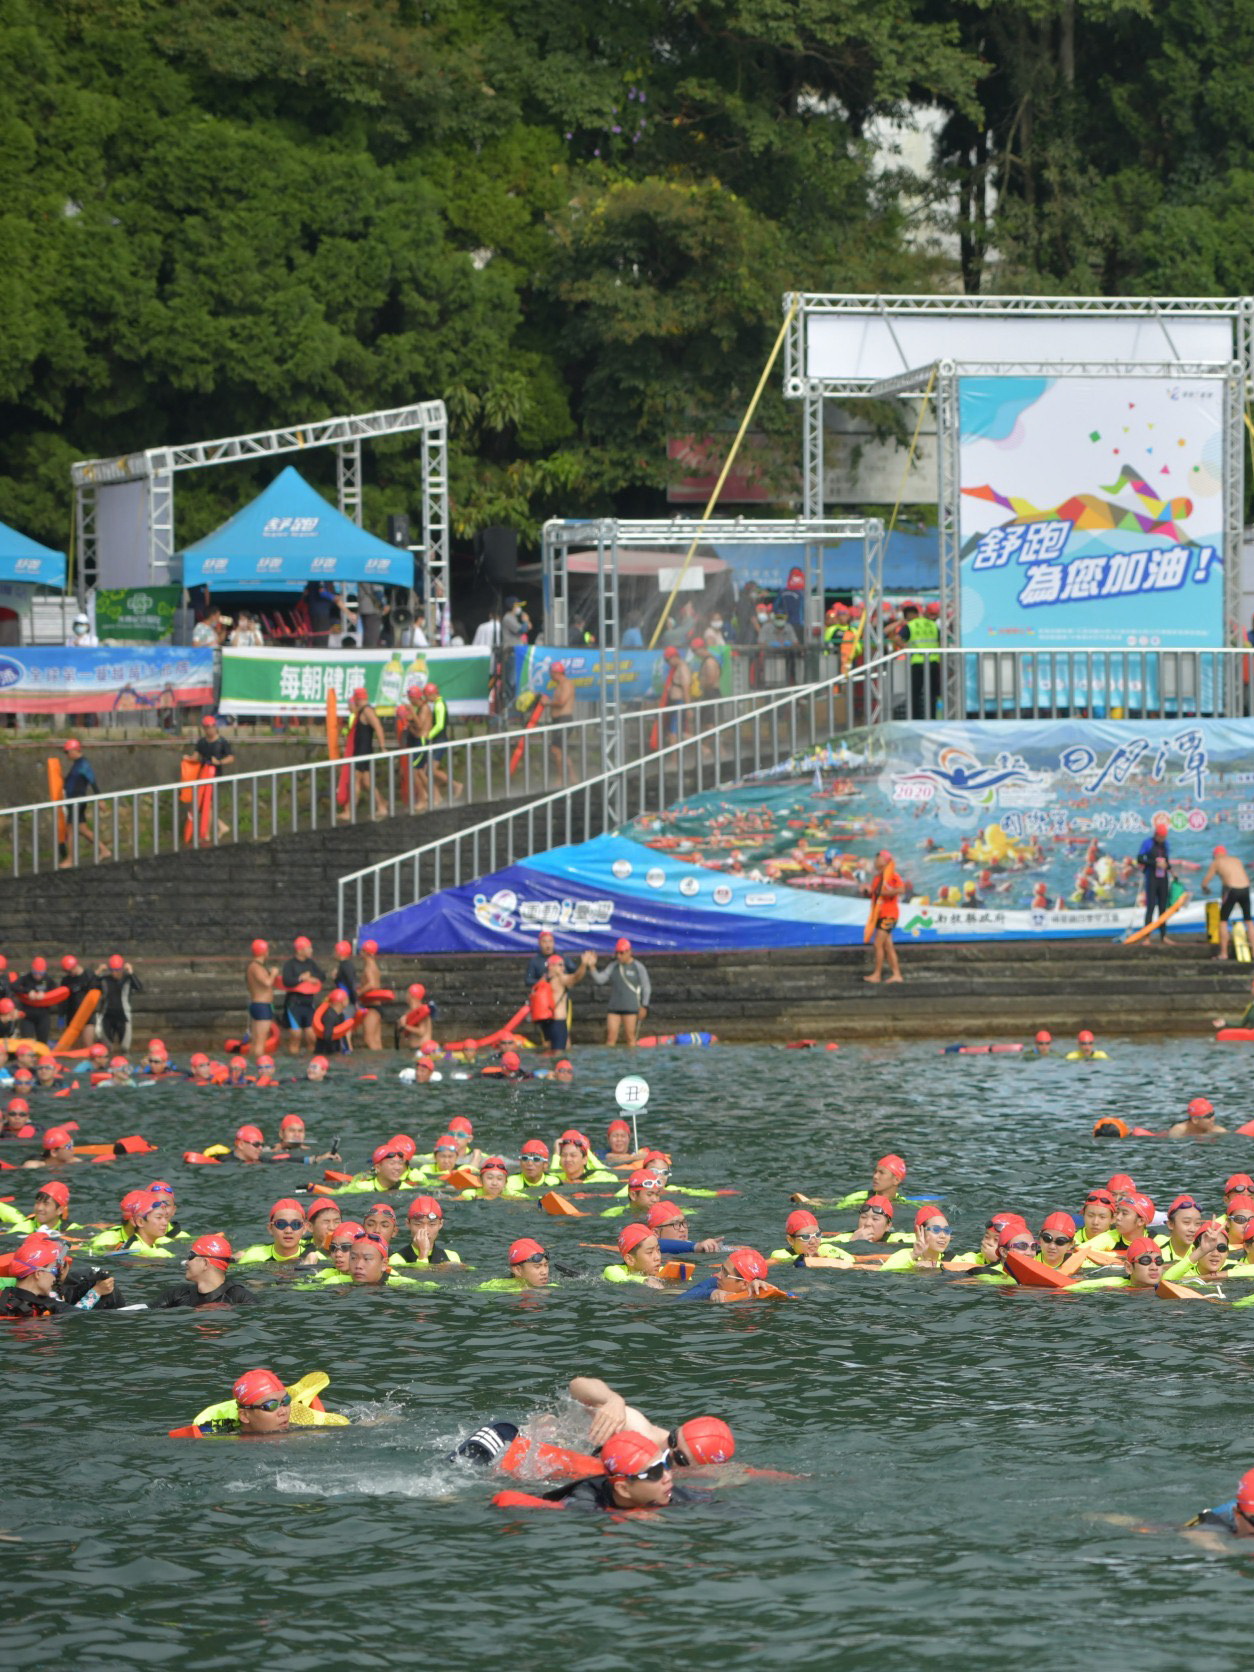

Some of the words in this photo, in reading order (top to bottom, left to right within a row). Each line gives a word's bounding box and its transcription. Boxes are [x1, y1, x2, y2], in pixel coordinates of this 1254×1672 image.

[264, 517, 319, 532] 舒跑
[973, 521, 1071, 569] 舒跑
[1021, 547, 1213, 604] 為您加油！
[279, 664, 366, 700] 每朝健康
[1063, 730, 1208, 799] 日月潭
[896, 785, 931, 799] 2020
[626, 1086, 639, 1101] 丑
